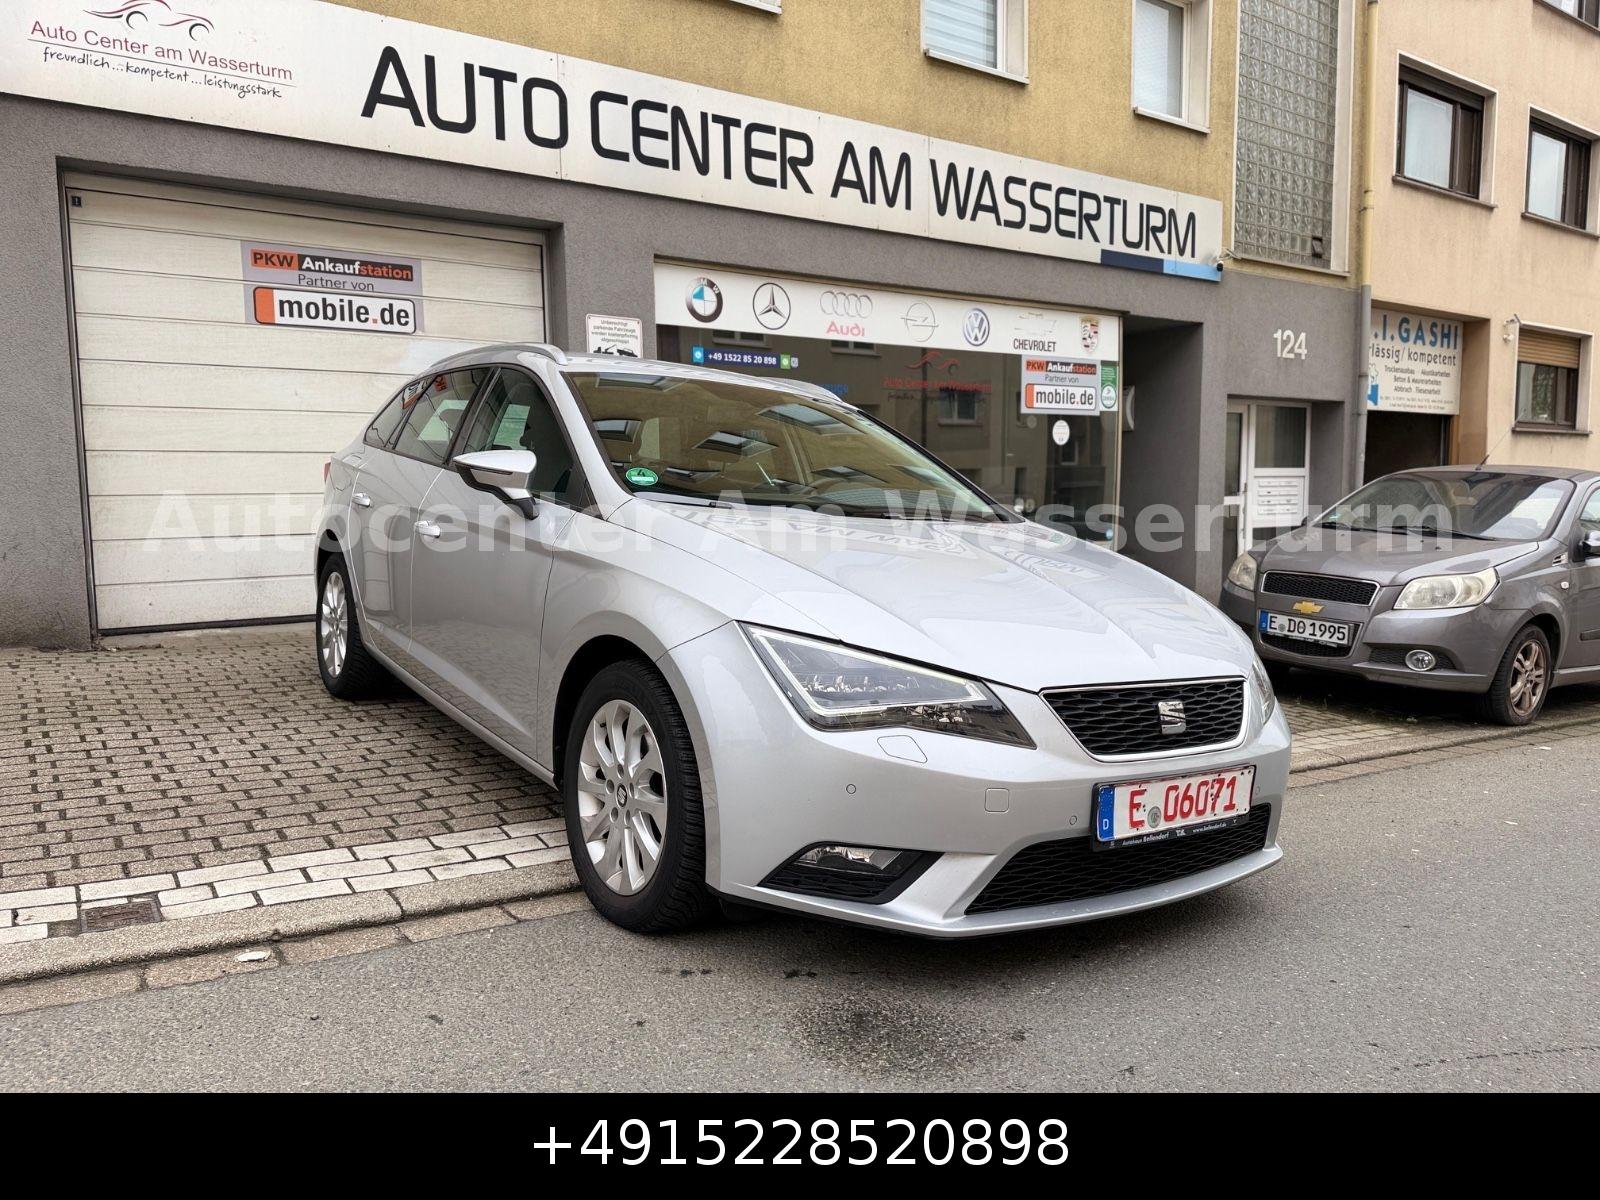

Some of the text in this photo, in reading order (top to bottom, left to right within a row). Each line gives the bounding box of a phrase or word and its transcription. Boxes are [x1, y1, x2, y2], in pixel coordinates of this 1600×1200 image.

[31, 20, 293, 81] Auto Center am Wasserturm
[361, 45, 1196, 259] AUTO CENTER AM WASSERTURM
[253, 252, 413, 280] PKW Ankaufstation
[298, 273, 374, 292] Partner von
[279, 297, 410, 327] mobile.de
[826, 320, 866, 337] Audi
[1012, 338, 1057, 352] CHEVROLET
[1272, 328, 1308, 360] 124
[708, 352, 777, 366] +49 1522 85 20 898
[1407, 347, 1456, 366] kompetent
[1026, 360, 1045, 371] PKW
[1047, 362, 1097, 375] Ankaufstation
[1045, 374, 1079, 384] Partner von
[1035, 389, 1094, 406] mobile.de
[637, 469, 646, 477] 4
[1269, 615, 1278, 631] E
[1308, 621, 1346, 642] 1995
[1102, 776, 1238, 831] D E 06071
